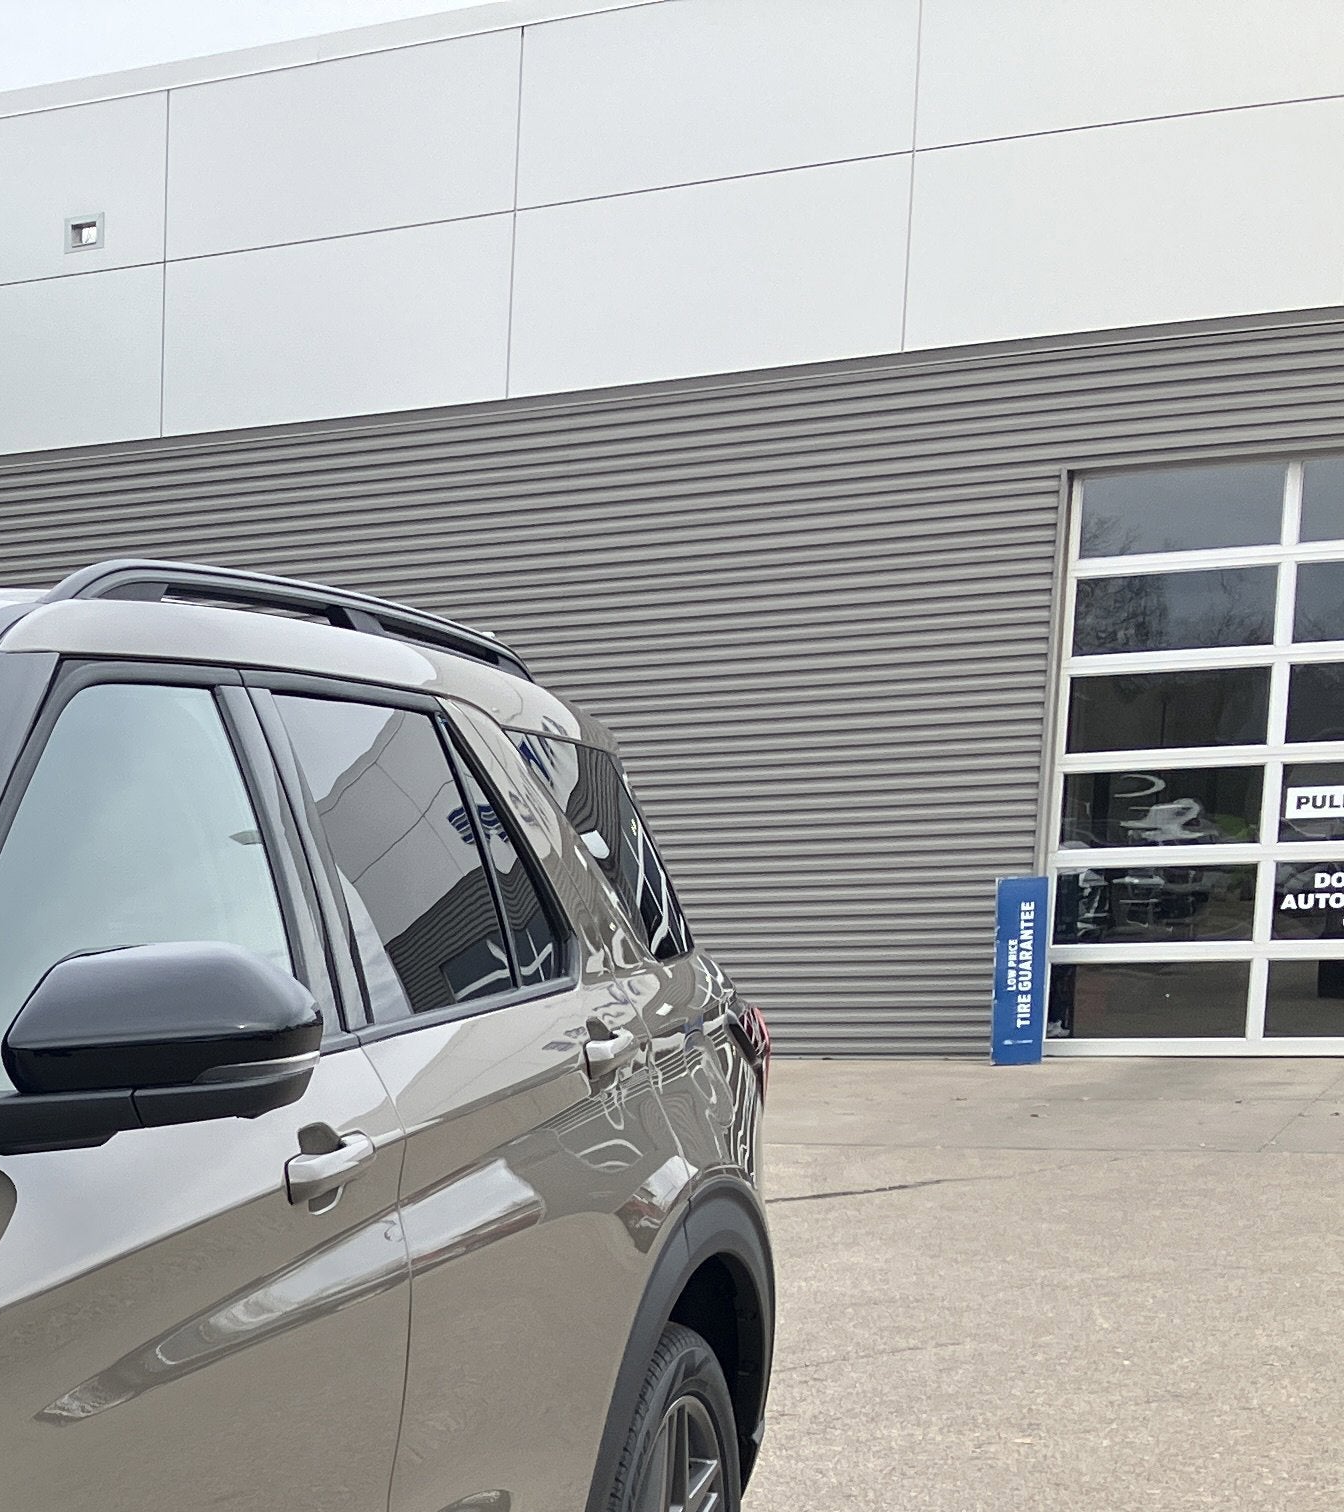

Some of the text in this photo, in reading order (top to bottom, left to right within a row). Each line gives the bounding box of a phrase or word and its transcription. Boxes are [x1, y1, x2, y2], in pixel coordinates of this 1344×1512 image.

[1296, 795, 1344, 810] PUL
[1314, 872, 1344, 888] DO
[1280, 892, 1344, 910] AUTO
[1007, 939, 1018, 991] LOW PRICE
[1017, 901, 1035, 1029] TIRE GUARANTEE
